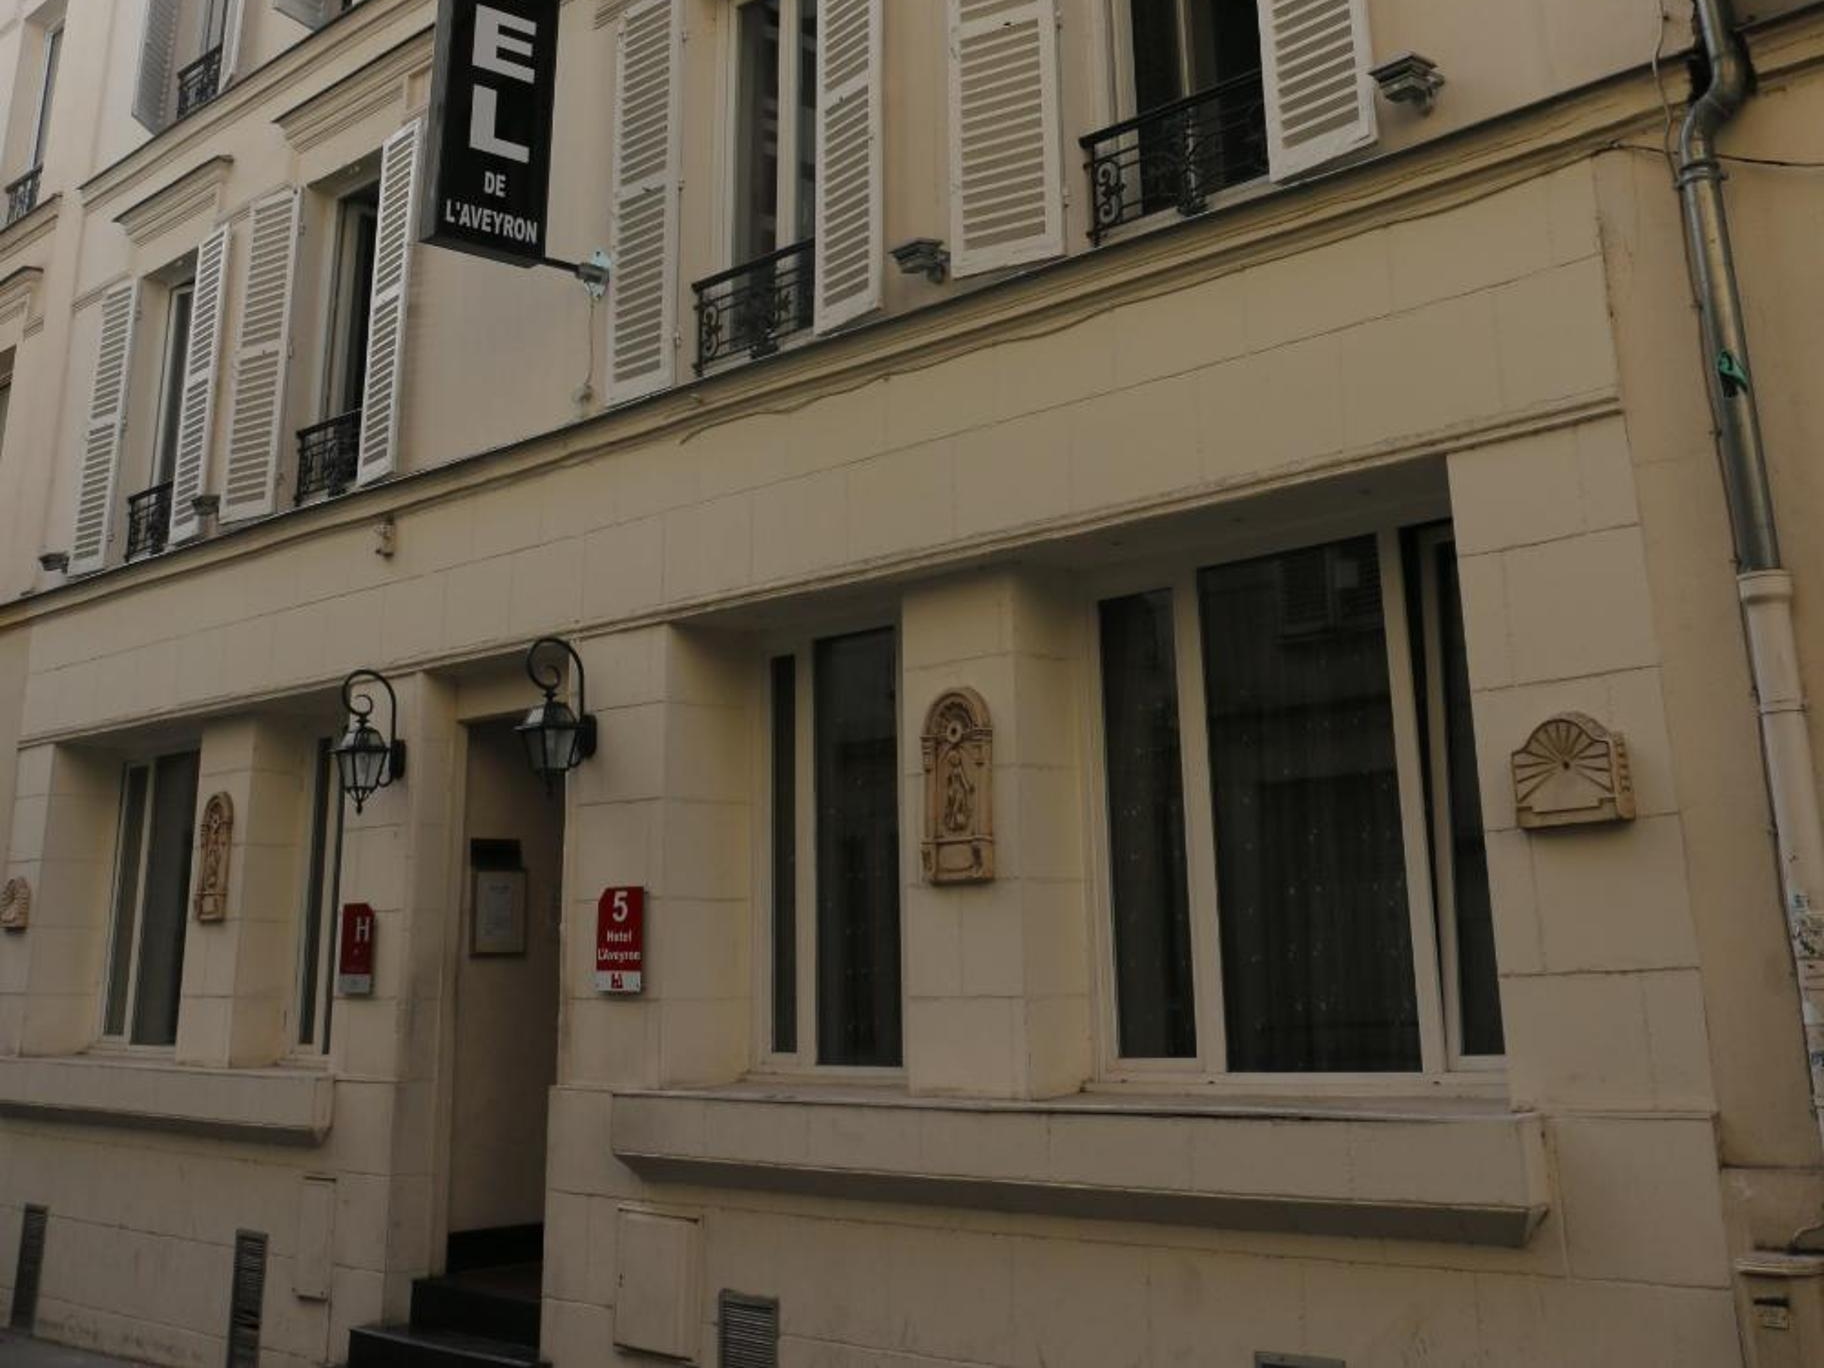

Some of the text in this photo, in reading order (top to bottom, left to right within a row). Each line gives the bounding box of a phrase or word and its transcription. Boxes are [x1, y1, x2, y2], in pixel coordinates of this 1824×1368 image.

[484, 170, 507, 198] DE
[446, 200, 537, 243] L'AVEYRON
[612, 890, 628, 922] 5
[356, 916, 370, 941] H
